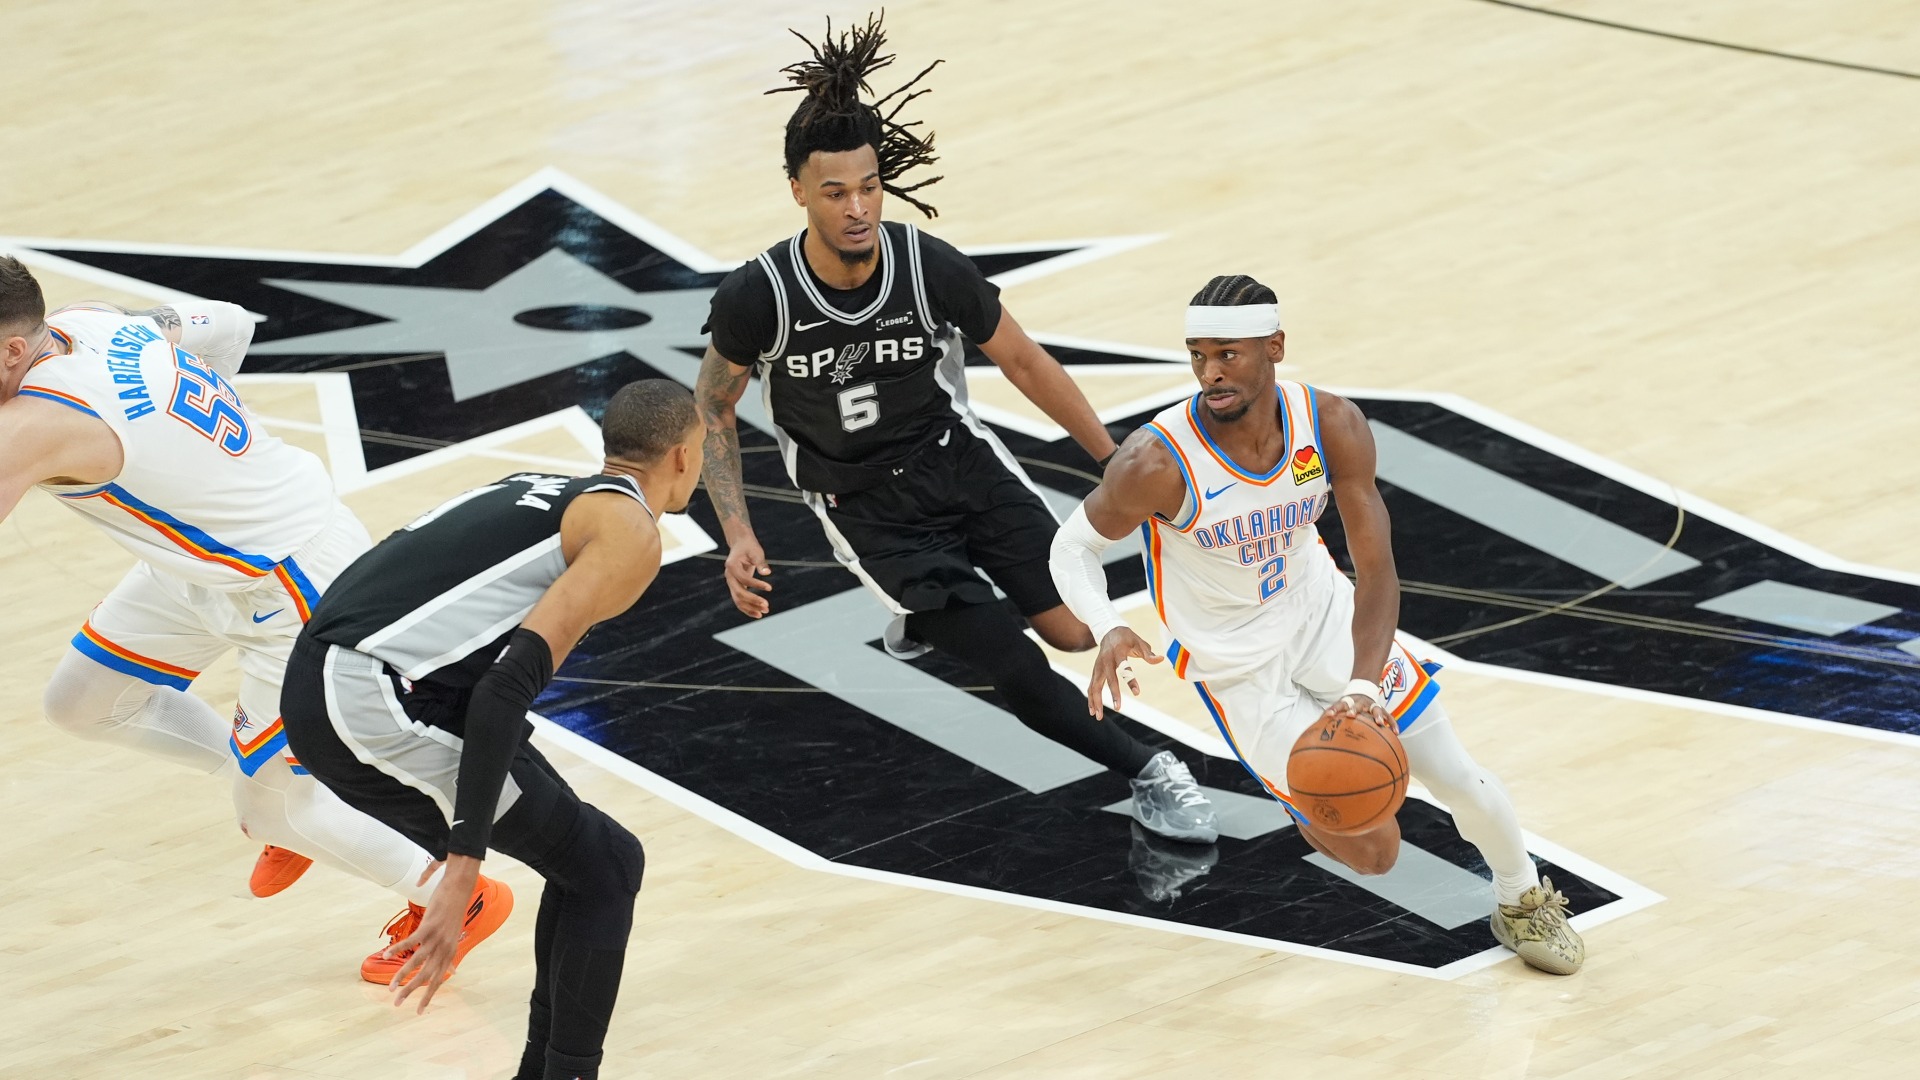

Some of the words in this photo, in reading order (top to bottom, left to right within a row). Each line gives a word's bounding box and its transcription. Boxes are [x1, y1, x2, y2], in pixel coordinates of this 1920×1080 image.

[880, 315, 909, 328] LEDGER
[166, 341, 252, 457] 55
[836, 382, 881, 433] 5
[1193, 491, 1329, 549] OKLAHOMA
[1238, 530, 1294, 566] CITY
[1258, 554, 1288, 605] 2
